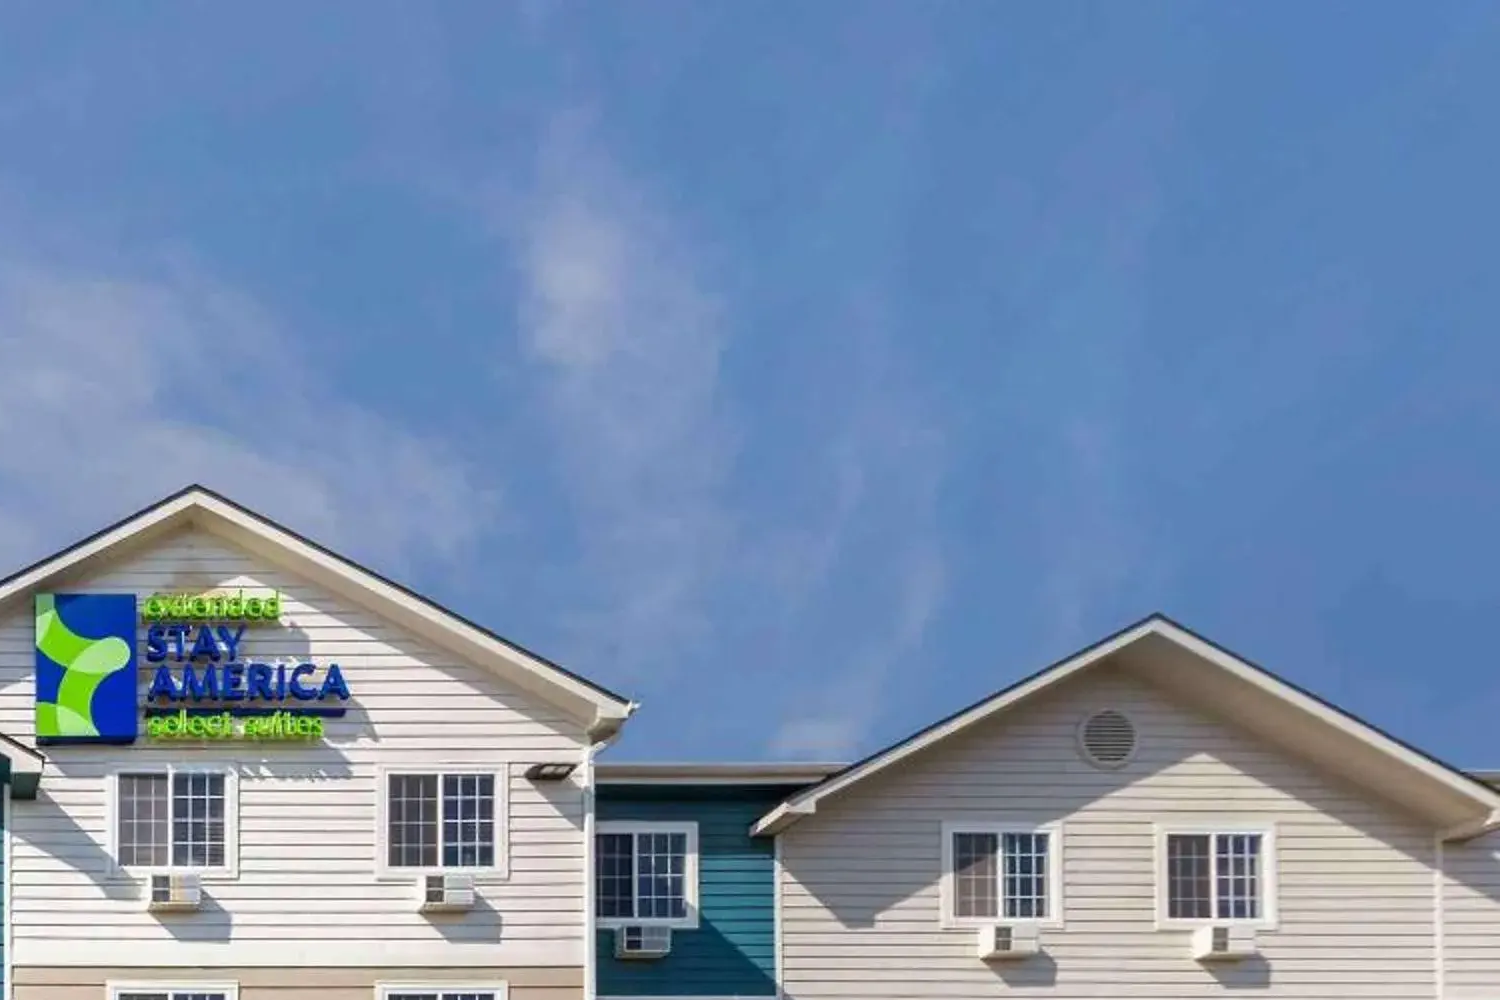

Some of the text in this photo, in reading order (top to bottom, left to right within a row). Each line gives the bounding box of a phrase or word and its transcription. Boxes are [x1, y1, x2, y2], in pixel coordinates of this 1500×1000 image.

[143, 591, 281, 621] extended
[146, 624, 246, 662] STAY
[147, 663, 350, 700] AMERICA
[149, 709, 324, 737] select suites
